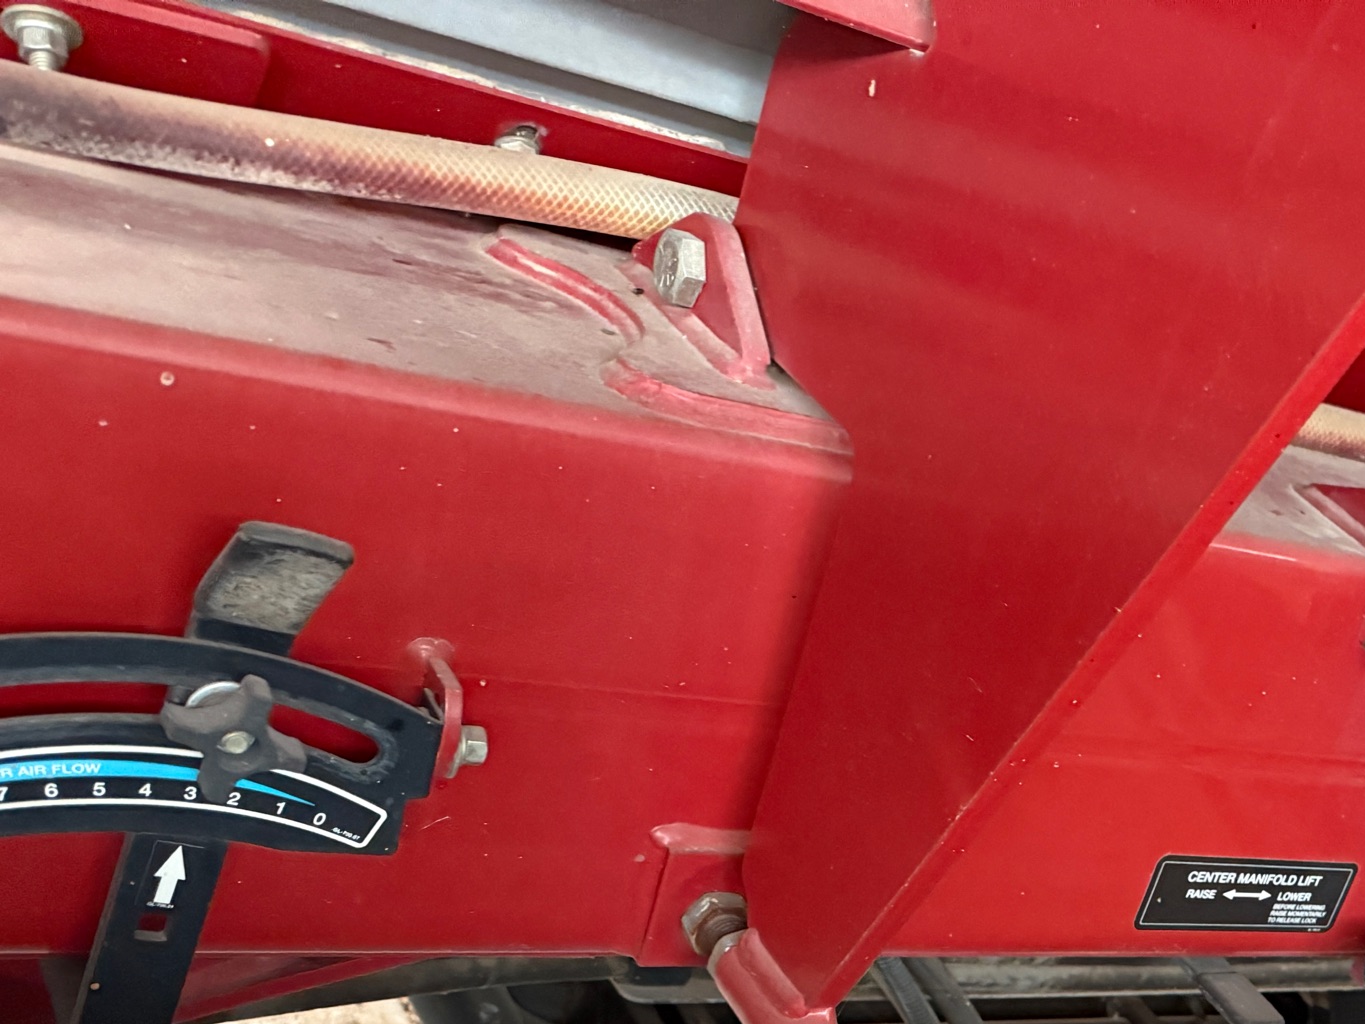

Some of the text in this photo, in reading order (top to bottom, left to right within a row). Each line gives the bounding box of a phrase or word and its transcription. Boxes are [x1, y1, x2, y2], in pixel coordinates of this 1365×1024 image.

[18, 765, 47, 777] AIR
[51, 762, 101, 775] FLOW
[0, 781, 327, 826] 7 6 5 4 3 2 1 0
[1187, 871, 1324, 887] CENTER MANIFOLD LIFT
[1185, 888, 1312, 902] RAISE LOWER
[1267, 916, 1277, 924] TO
